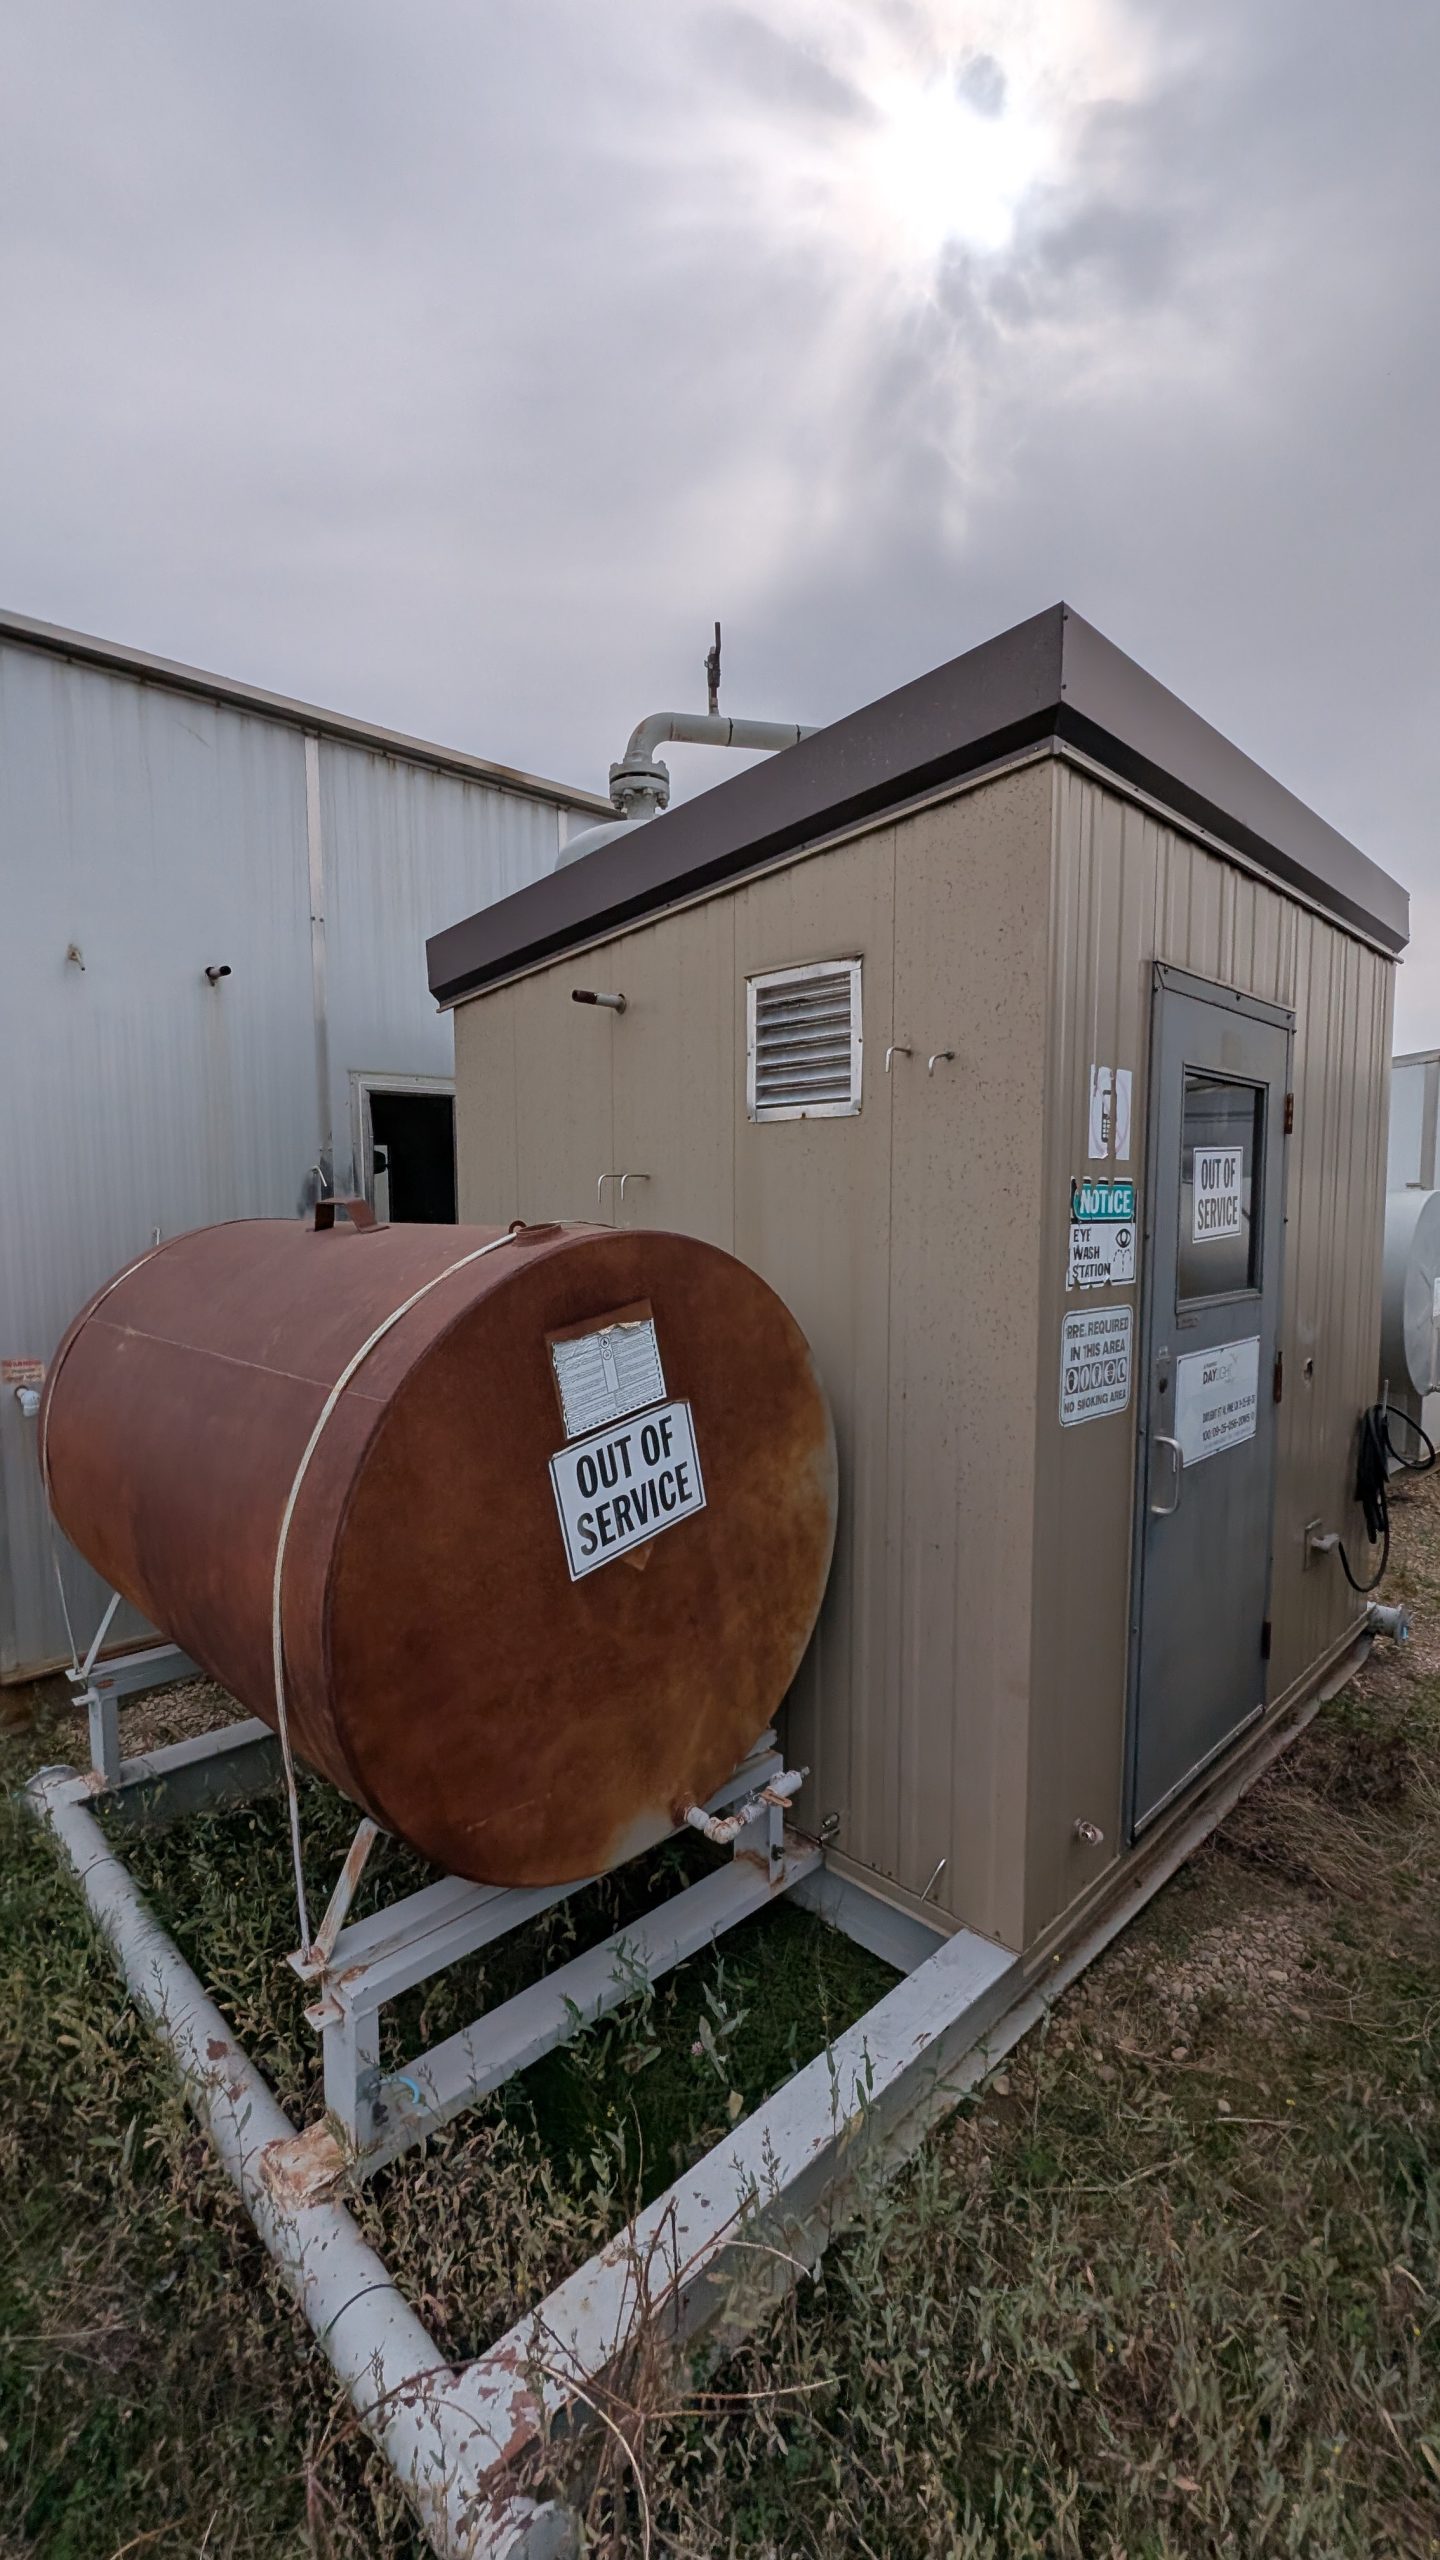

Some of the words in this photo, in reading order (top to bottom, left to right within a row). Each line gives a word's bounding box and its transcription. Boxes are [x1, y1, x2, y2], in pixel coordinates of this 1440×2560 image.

[1201, 1159, 1221, 1190] OUT
[1224, 1158, 1236, 1188] OF
[1080, 1189, 1131, 1214] NOTICE
[1198, 1196, 1238, 1230] SERVICE
[1073, 1228, 1091, 1242] EYE
[1073, 1245, 1100, 1260] WASH
[1072, 1262, 1111, 1279] STATION
[1088, 1317, 1129, 1336] REQUIRED
[1070, 1346, 1080, 1361] IN
[1083, 1342, 1100, 1358] THIS
[1102, 1338, 1125, 1355] AREA
[1064, 1402, 1074, 1414] NO
[1077, 1393, 1108, 1410] SMOKING
[1110, 1389, 1126, 1402] AREA
[576, 1435, 631, 1498] OUT
[640, 1415, 672, 1467] OF
[577, 1461, 693, 1556] SERVICE
